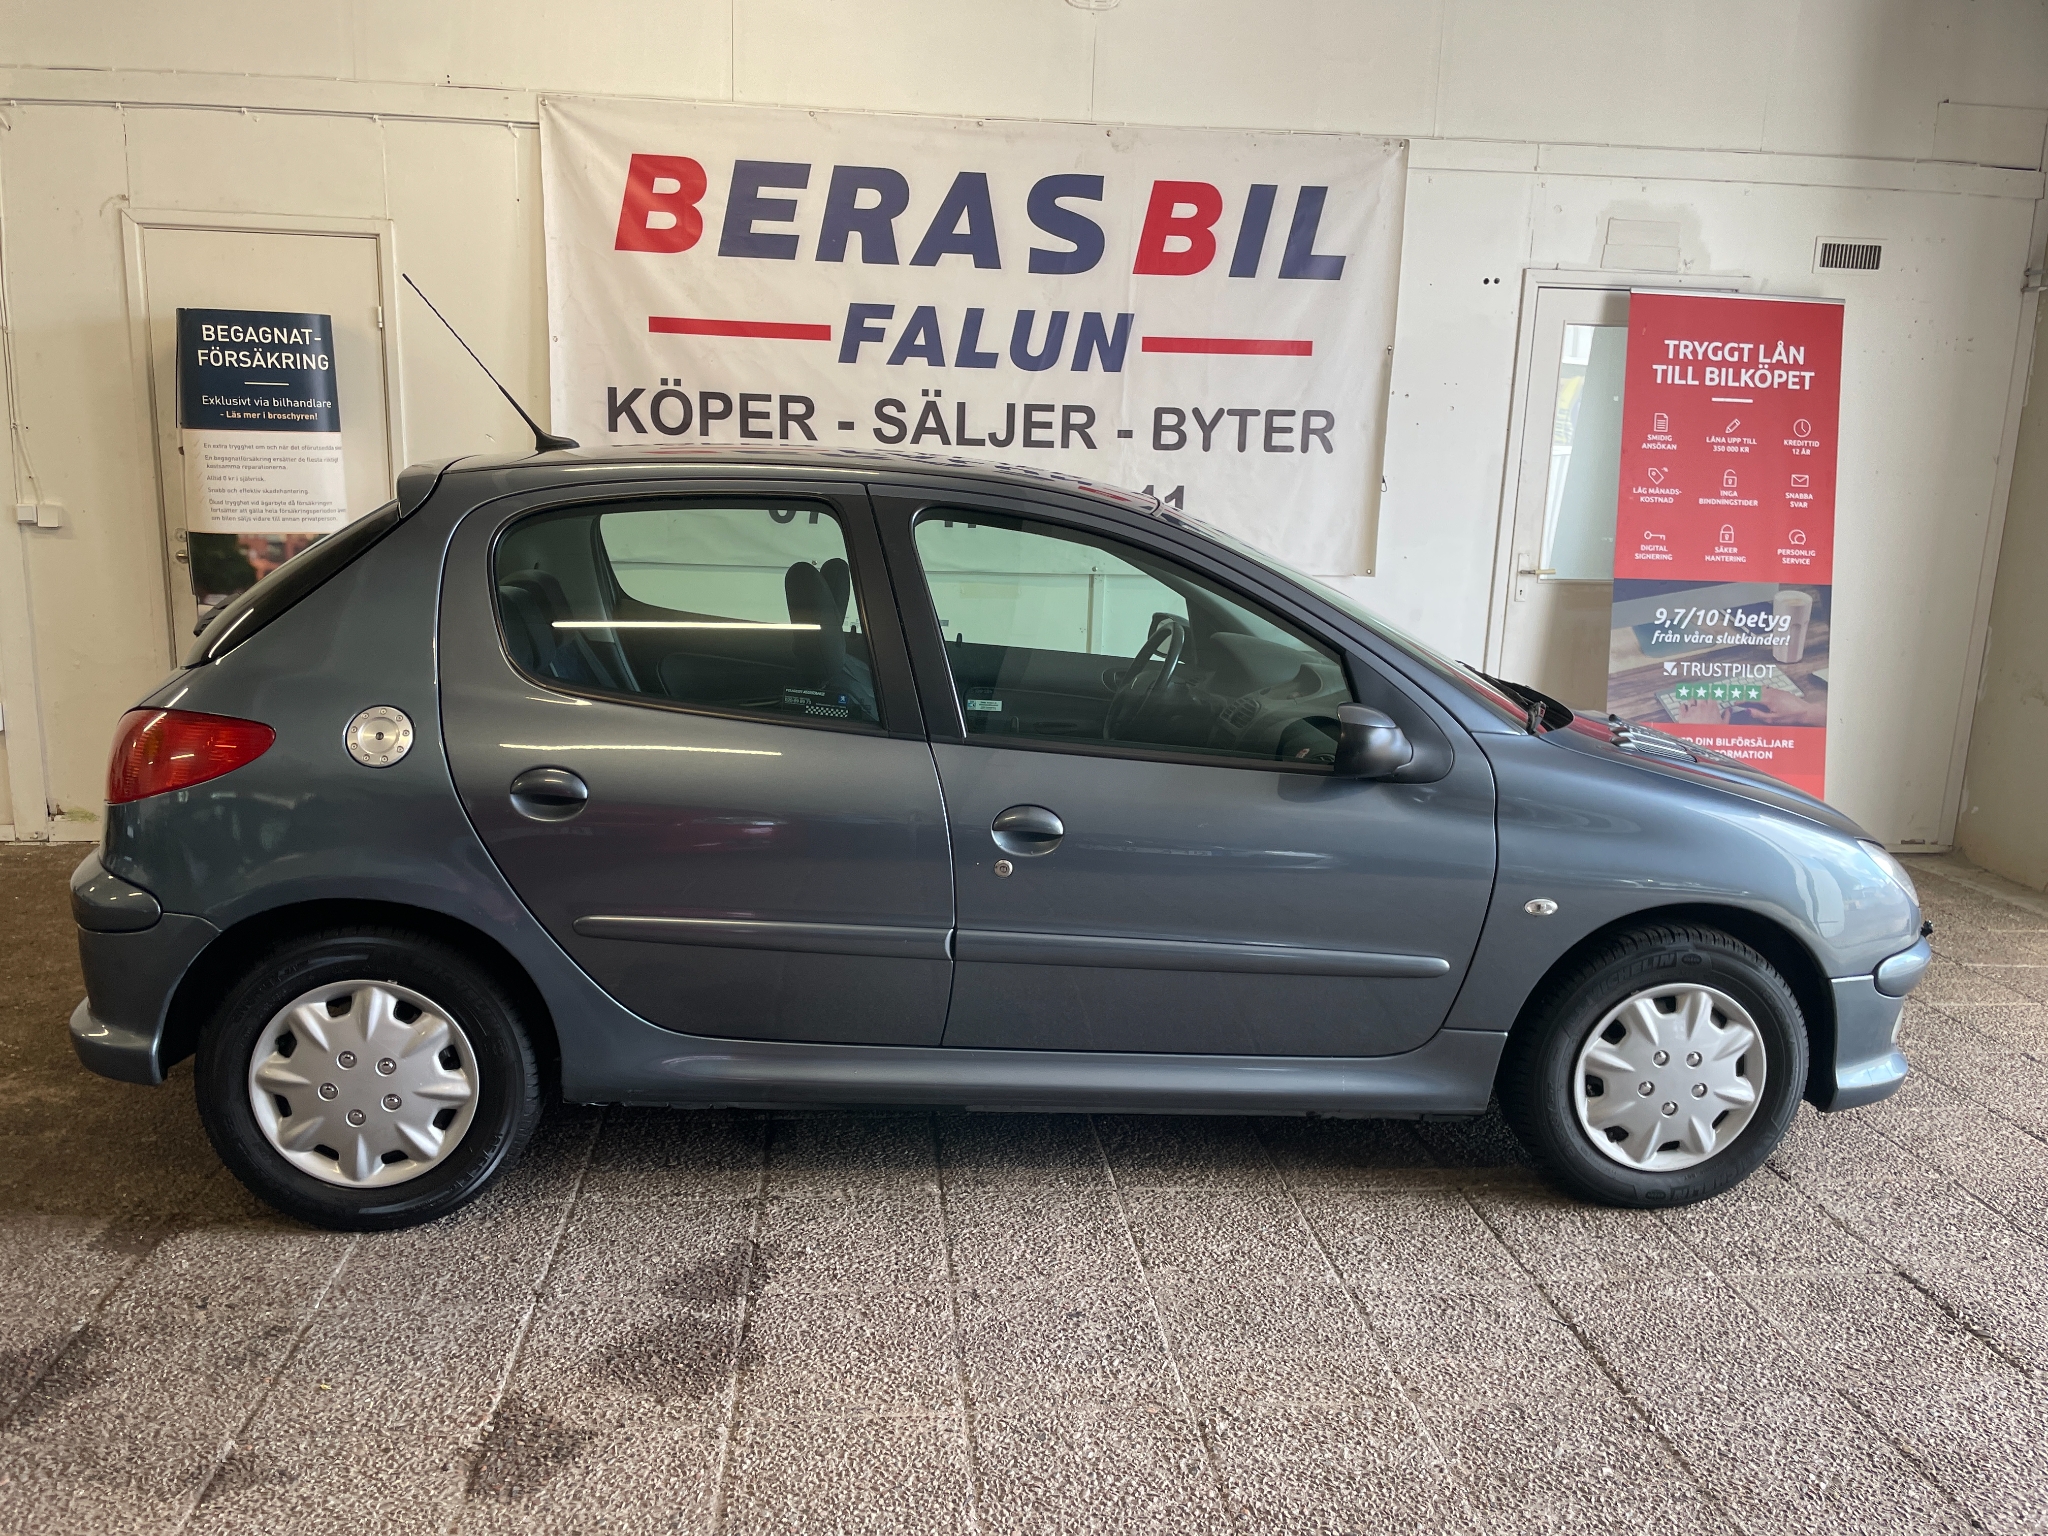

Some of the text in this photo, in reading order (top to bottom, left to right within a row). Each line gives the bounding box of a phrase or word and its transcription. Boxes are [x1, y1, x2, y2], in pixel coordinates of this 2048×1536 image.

[615, 153, 1347, 281] BERAS BIL
[201, 324, 322, 345] BEGAGNAT-
[837, 302, 1135, 372] FALUN
[1664, 339, 1805, 366] TRYGGT LÅN
[197, 346, 329, 371] FÖRSÄKRING
[1652, 364, 1816, 390] TILL BILKÖPET
[202, 395, 332, 409] Exklusivt via bilhandlare
[226, 410, 242, 419] Läs
[263, 411, 266, 419] i
[267, 411, 318, 421] broschyren!
[606, 377, 1336, 454] KÖPER - SÄLJER - BYTER
[1647, 434, 1672, 442] SMIDIG
[1706, 436, 1726, 444] LÅNA
[1642, 442, 1677, 450] ANSÖKAN
[1783, 440, 1820, 448] KREDITTID
[1648, 487, 1682, 496] MÅNADS-
[1785, 492, 1814, 500] SNABBA
[1640, 496, 1674, 504] KOSTNAD
[1698, 498, 1758, 507] BINDNINGSTIDER
[1790, 500, 1808, 508] SVAR
[1640, 544, 1668, 552] DIGITAL
[1714, 546, 1738, 554] SÄKER
[1777, 548, 1816, 557] PERSONLIG
[1634, 552, 1672, 561] SIGNERING
[1704, 554, 1746, 563] HANTERING
[1782, 558, 1811, 566] SERVICE
[1654, 606, 1792, 632] 9,7/10 i betyg
[1652, 630, 1791, 646] från våra slutkunder!
[1680, 661, 1776, 679] TRUSTPILOT
[1695, 737, 1714, 746] DIN
[1716, 736, 1794, 749] BILFÖRSÄLJARE
